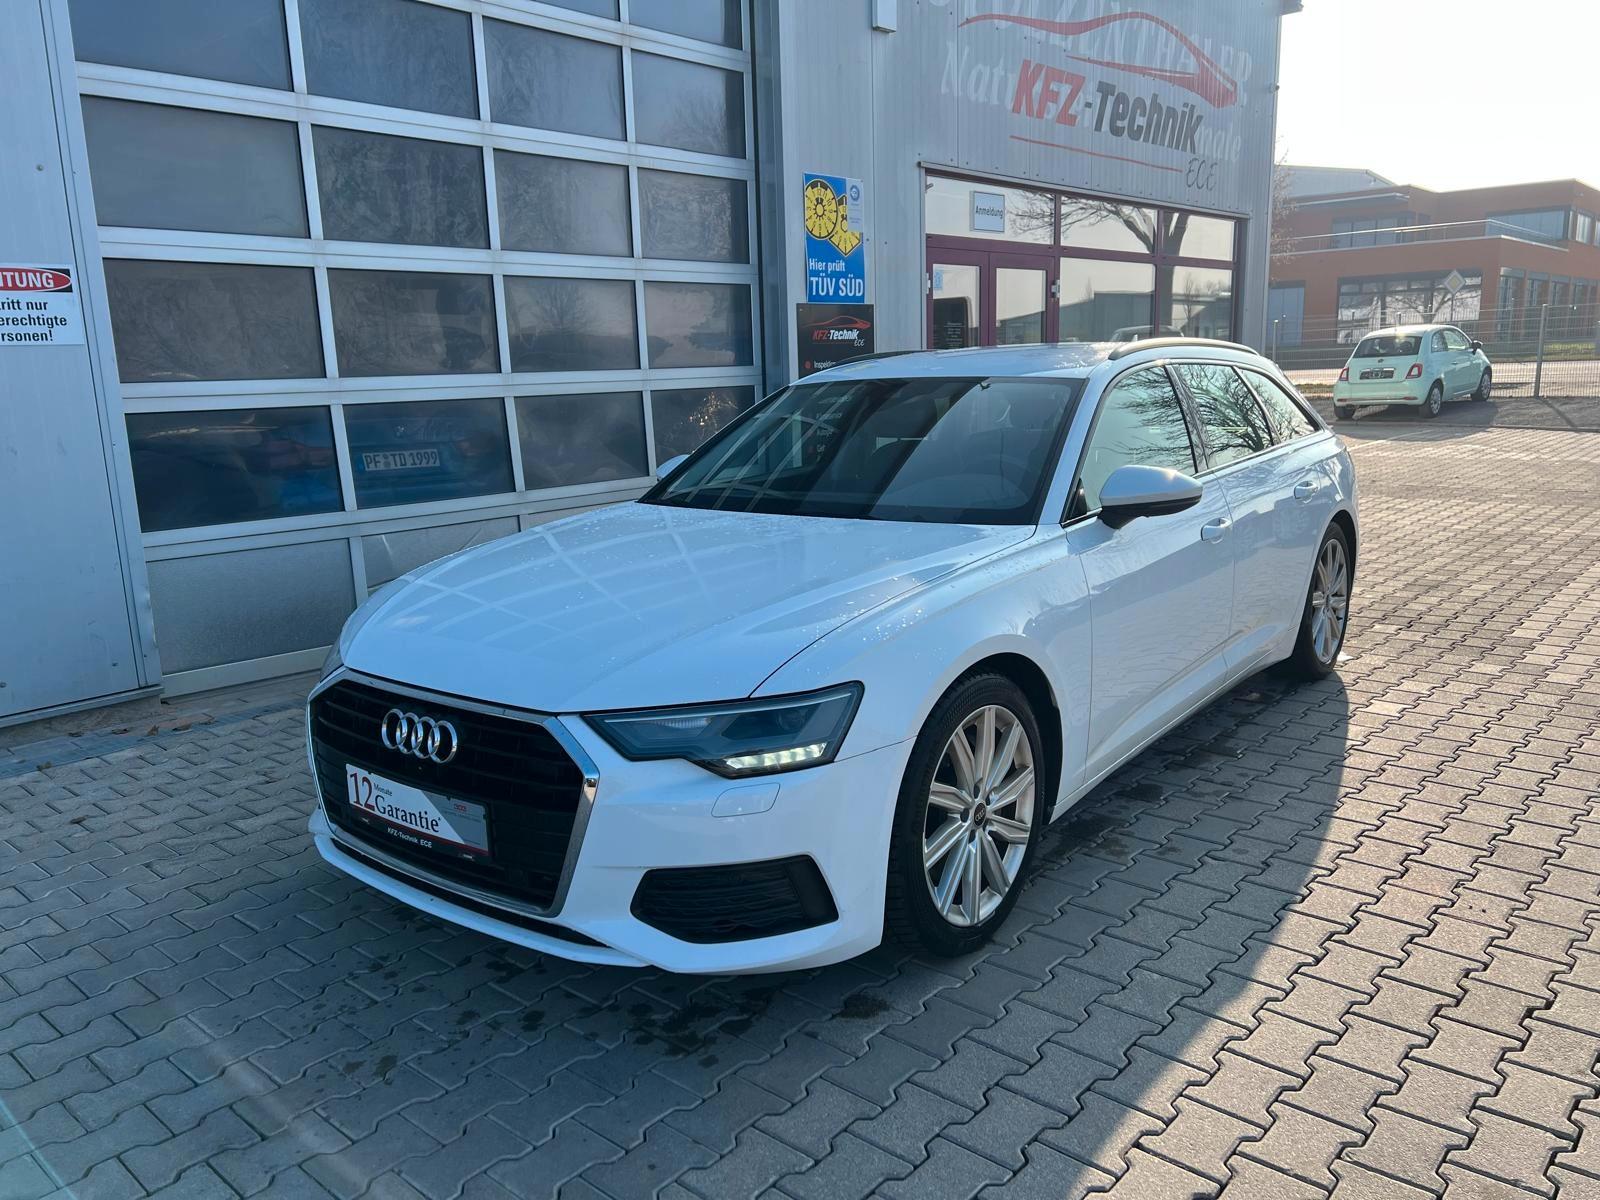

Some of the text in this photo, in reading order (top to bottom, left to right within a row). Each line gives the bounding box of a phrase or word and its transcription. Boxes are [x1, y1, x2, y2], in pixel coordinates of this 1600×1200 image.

[1012, 59, 1203, 154] KFZ-Technik
[1186, 157, 1218, 192] ECE
[975, 205, 1004, 220] Anmeldung
[809, 258, 846, 274] Hier prüft
[810, 272, 864, 297] TÜV SÜD
[0, 298, 48, 311] ritt nur
[813, 329, 860, 340] KFZ-Technik
[854, 339, 865, 347] ECE
[363, 451, 438, 469] PF TD 1999
[350, 772, 393, 812] 12 Monate
[387, 826, 433, 849] KFZ-Technik ECE
